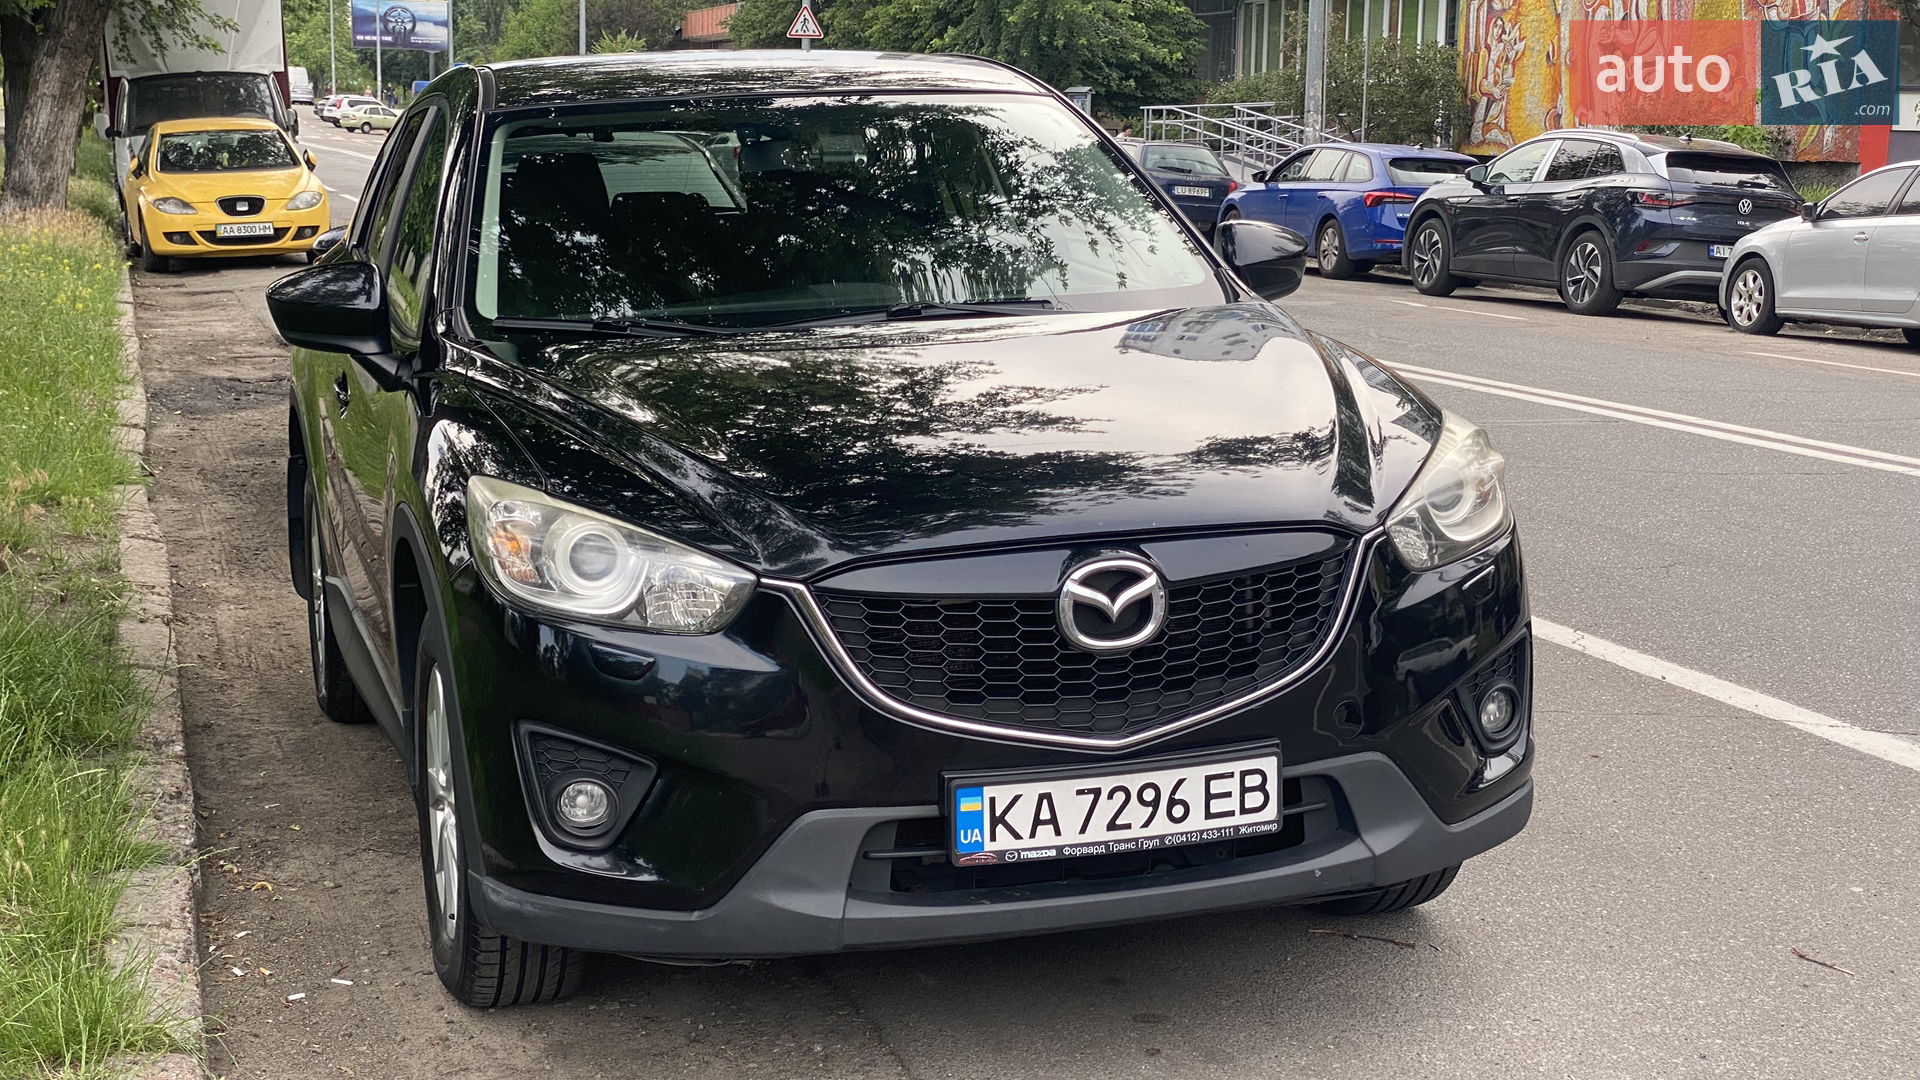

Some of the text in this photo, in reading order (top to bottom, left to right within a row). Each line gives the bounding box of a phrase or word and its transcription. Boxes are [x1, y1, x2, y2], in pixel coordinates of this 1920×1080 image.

[223, 224, 272, 234] AA 8300 HM
[988, 768, 1270, 843] KA 7296 EB
[960, 828, 982, 844] UA
[1063, 844, 1106, 856] Форвард
[1108, 840, 1136, 852] Транс
[1139, 838, 1160, 850] Груп
[1202, 828, 1234, 840] 433-111
[1238, 822, 1278, 835] Житомир
[1019, 848, 1057, 859] mazda
